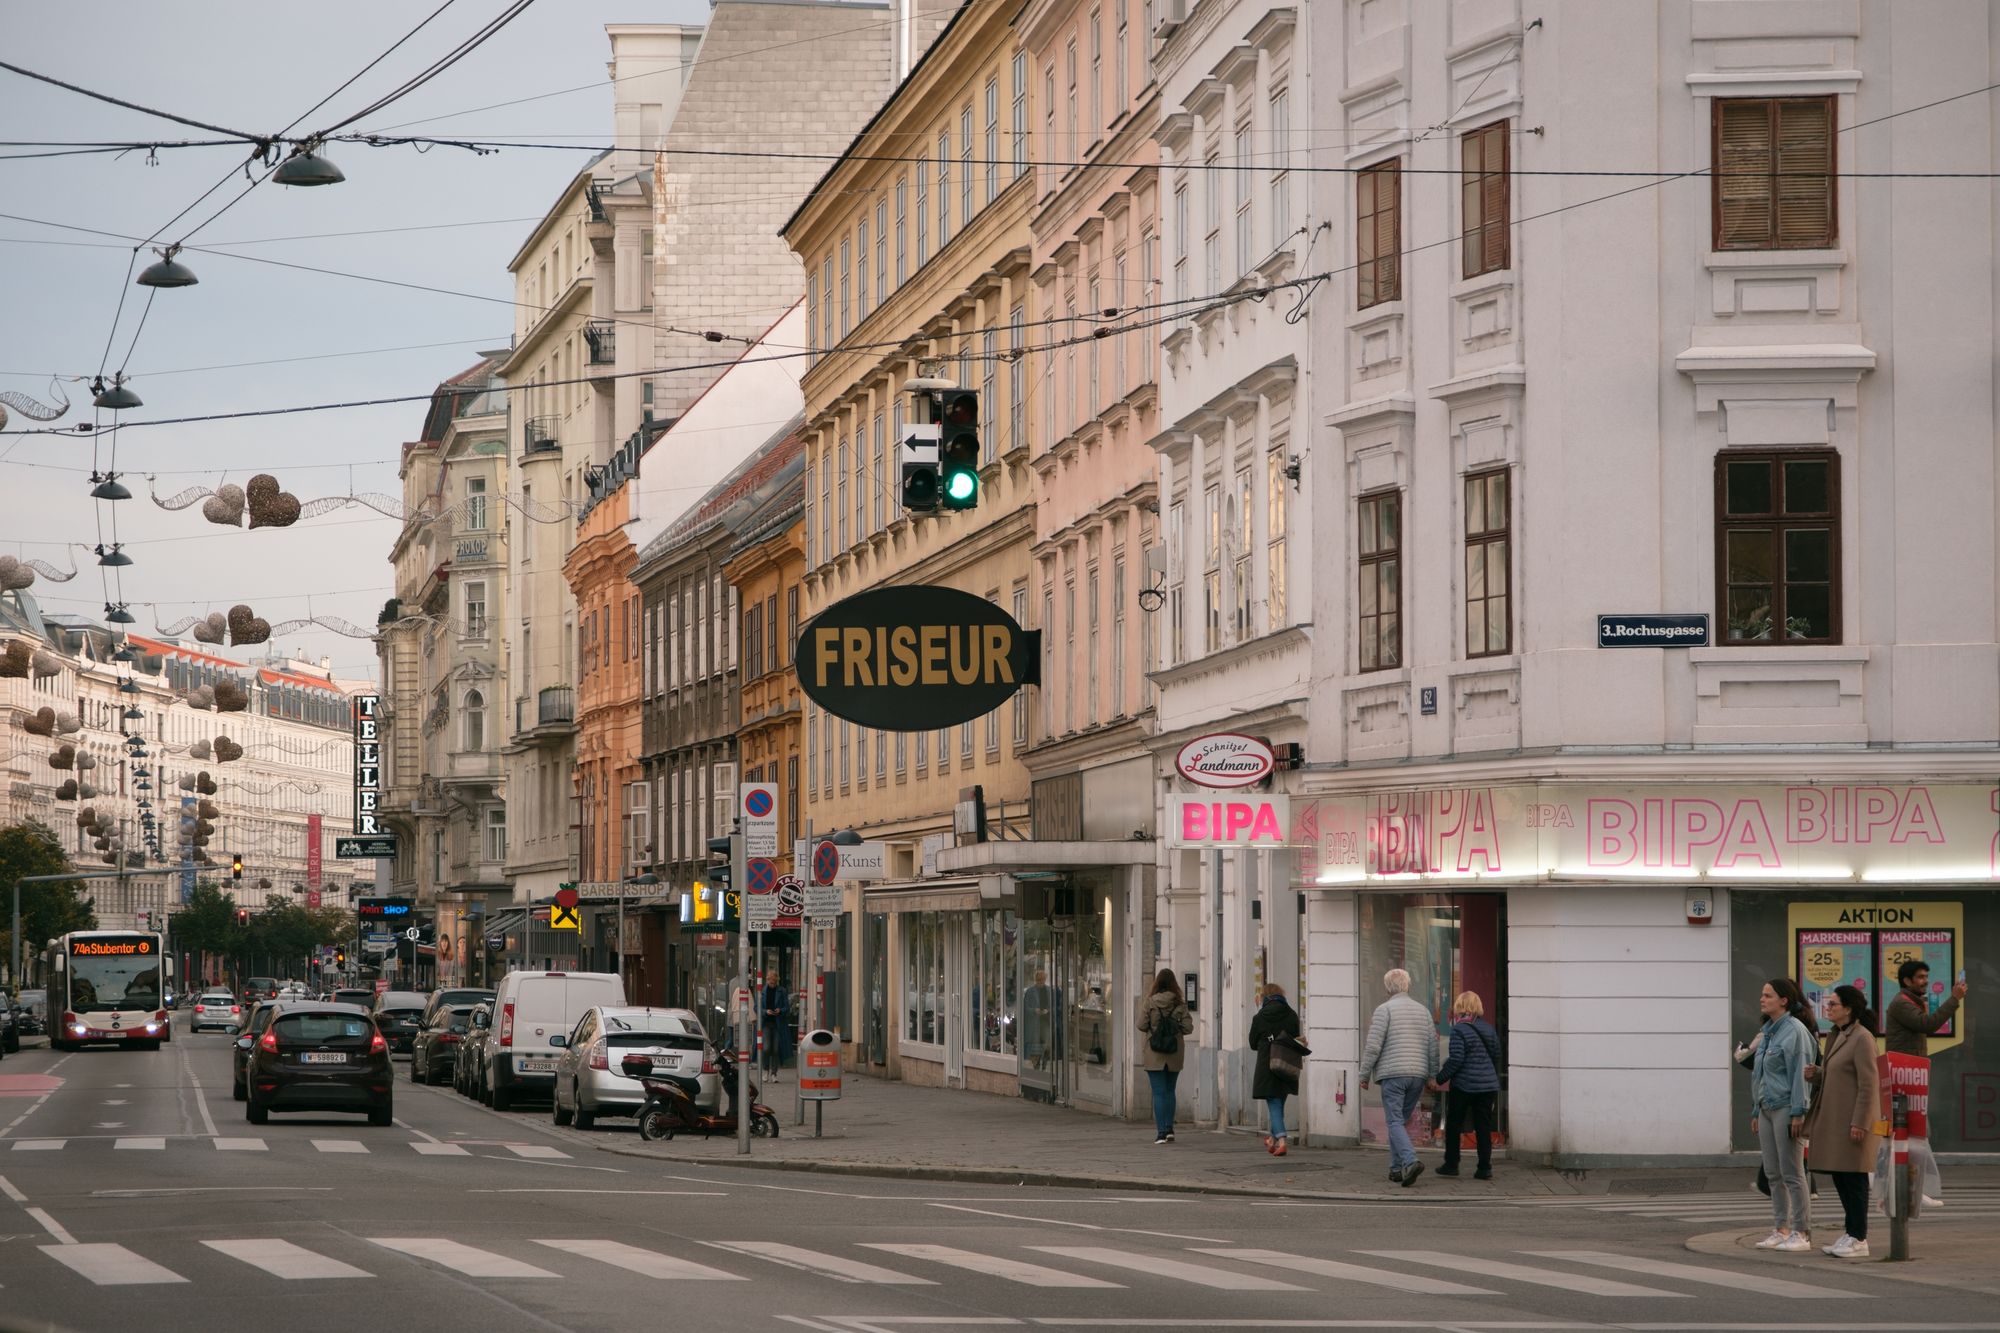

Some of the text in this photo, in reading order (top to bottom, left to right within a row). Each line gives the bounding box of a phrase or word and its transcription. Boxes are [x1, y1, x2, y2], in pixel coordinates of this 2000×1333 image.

[815, 624, 1014, 687] FRISEUR
[1424, 690, 1433, 705] 62
[1202, 741, 1249, 756] Schnitzel
[362, 697, 377, 834] TELLER
[1185, 754, 1260, 772] Landmann
[1183, 803, 1283, 841] BIPA
[1525, 803, 1575, 828] BIPA
[1786, 787, 1946, 843] BIPA
[1378, 788, 1502, 874] BIPA
[1586, 798, 1782, 868] BIPA
[1325, 831, 1359, 865] BIPA
[841, 853, 883, 868] Kunst
[580, 883, 665, 897] BARBERSHOP
[813, 919, 834, 927] Anfang
[1838, 908, 1913, 923] AKTION
[751, 921, 767, 929] Ende
[1802, 932, 1871, 943] MARKENHIT
[1881, 931, 1951, 943] MARKENHIT
[91, 943, 136, 954] Stubentor
[350, 1025, 358, 1033] L
